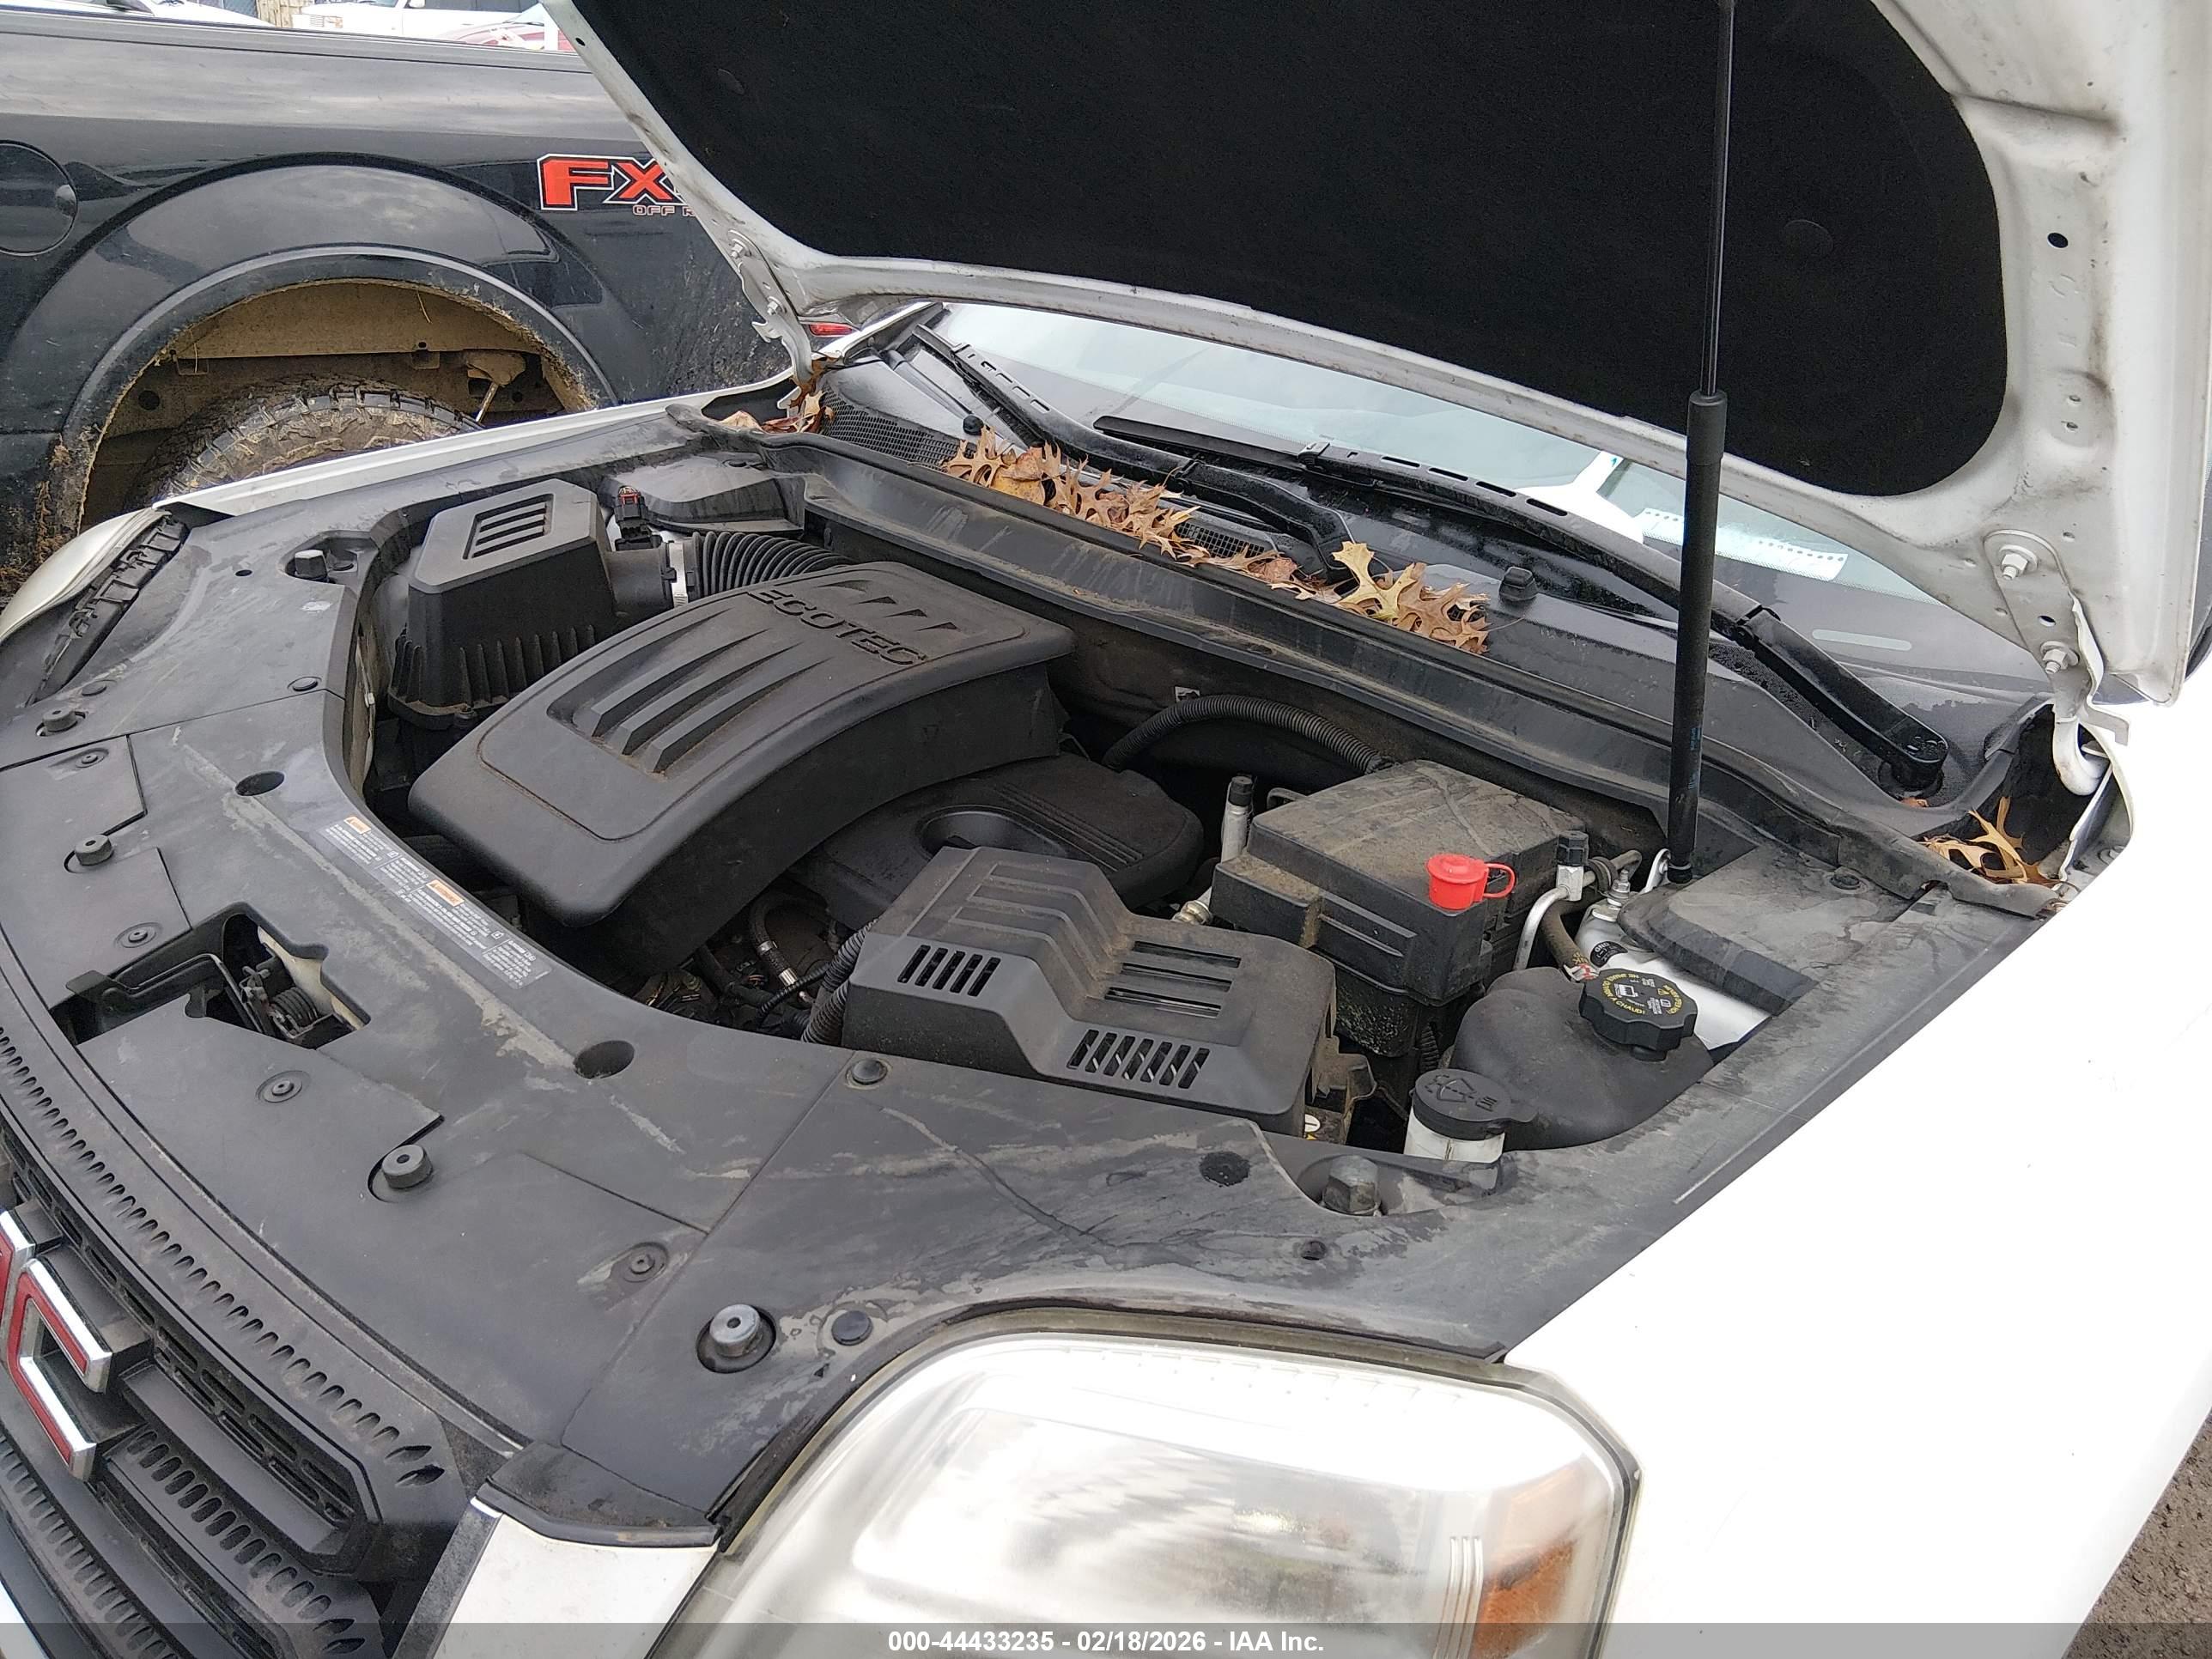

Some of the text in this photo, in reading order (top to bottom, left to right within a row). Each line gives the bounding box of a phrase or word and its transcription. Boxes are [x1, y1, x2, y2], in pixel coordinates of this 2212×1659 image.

[537, 154, 687, 211] FX
[632, 204, 676, 216] OFF
[746, 589, 927, 665] ECOTEC
